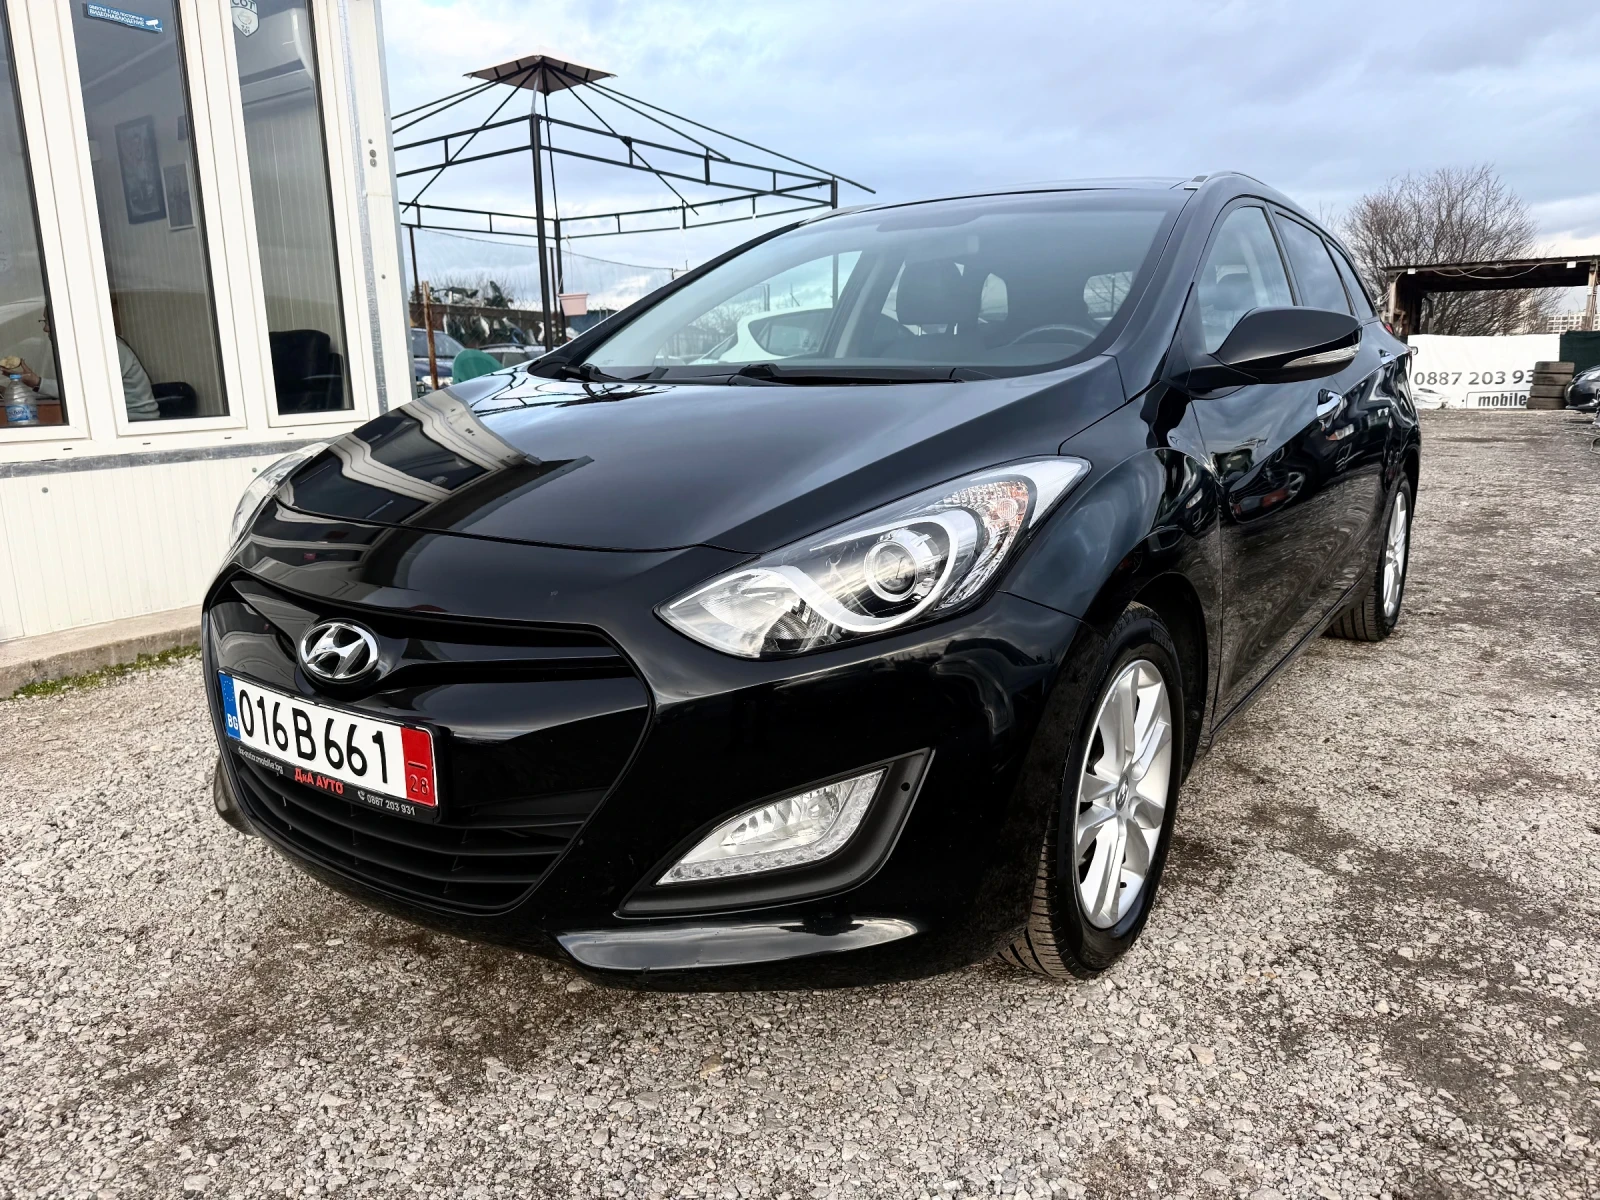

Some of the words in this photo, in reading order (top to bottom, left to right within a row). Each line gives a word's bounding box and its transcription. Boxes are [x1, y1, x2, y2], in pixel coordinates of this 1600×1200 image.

[1413, 371, 1463, 386] 0887
[1468, 371, 1506, 386] 203
[1478, 393, 1527, 407] mobile
[227, 713, 239, 731] BG
[316, 775, 344, 795] АУТО
[409, 774, 430, 795] 28
[385, 799, 401, 811] 203
[400, 804, 416, 816] 931
